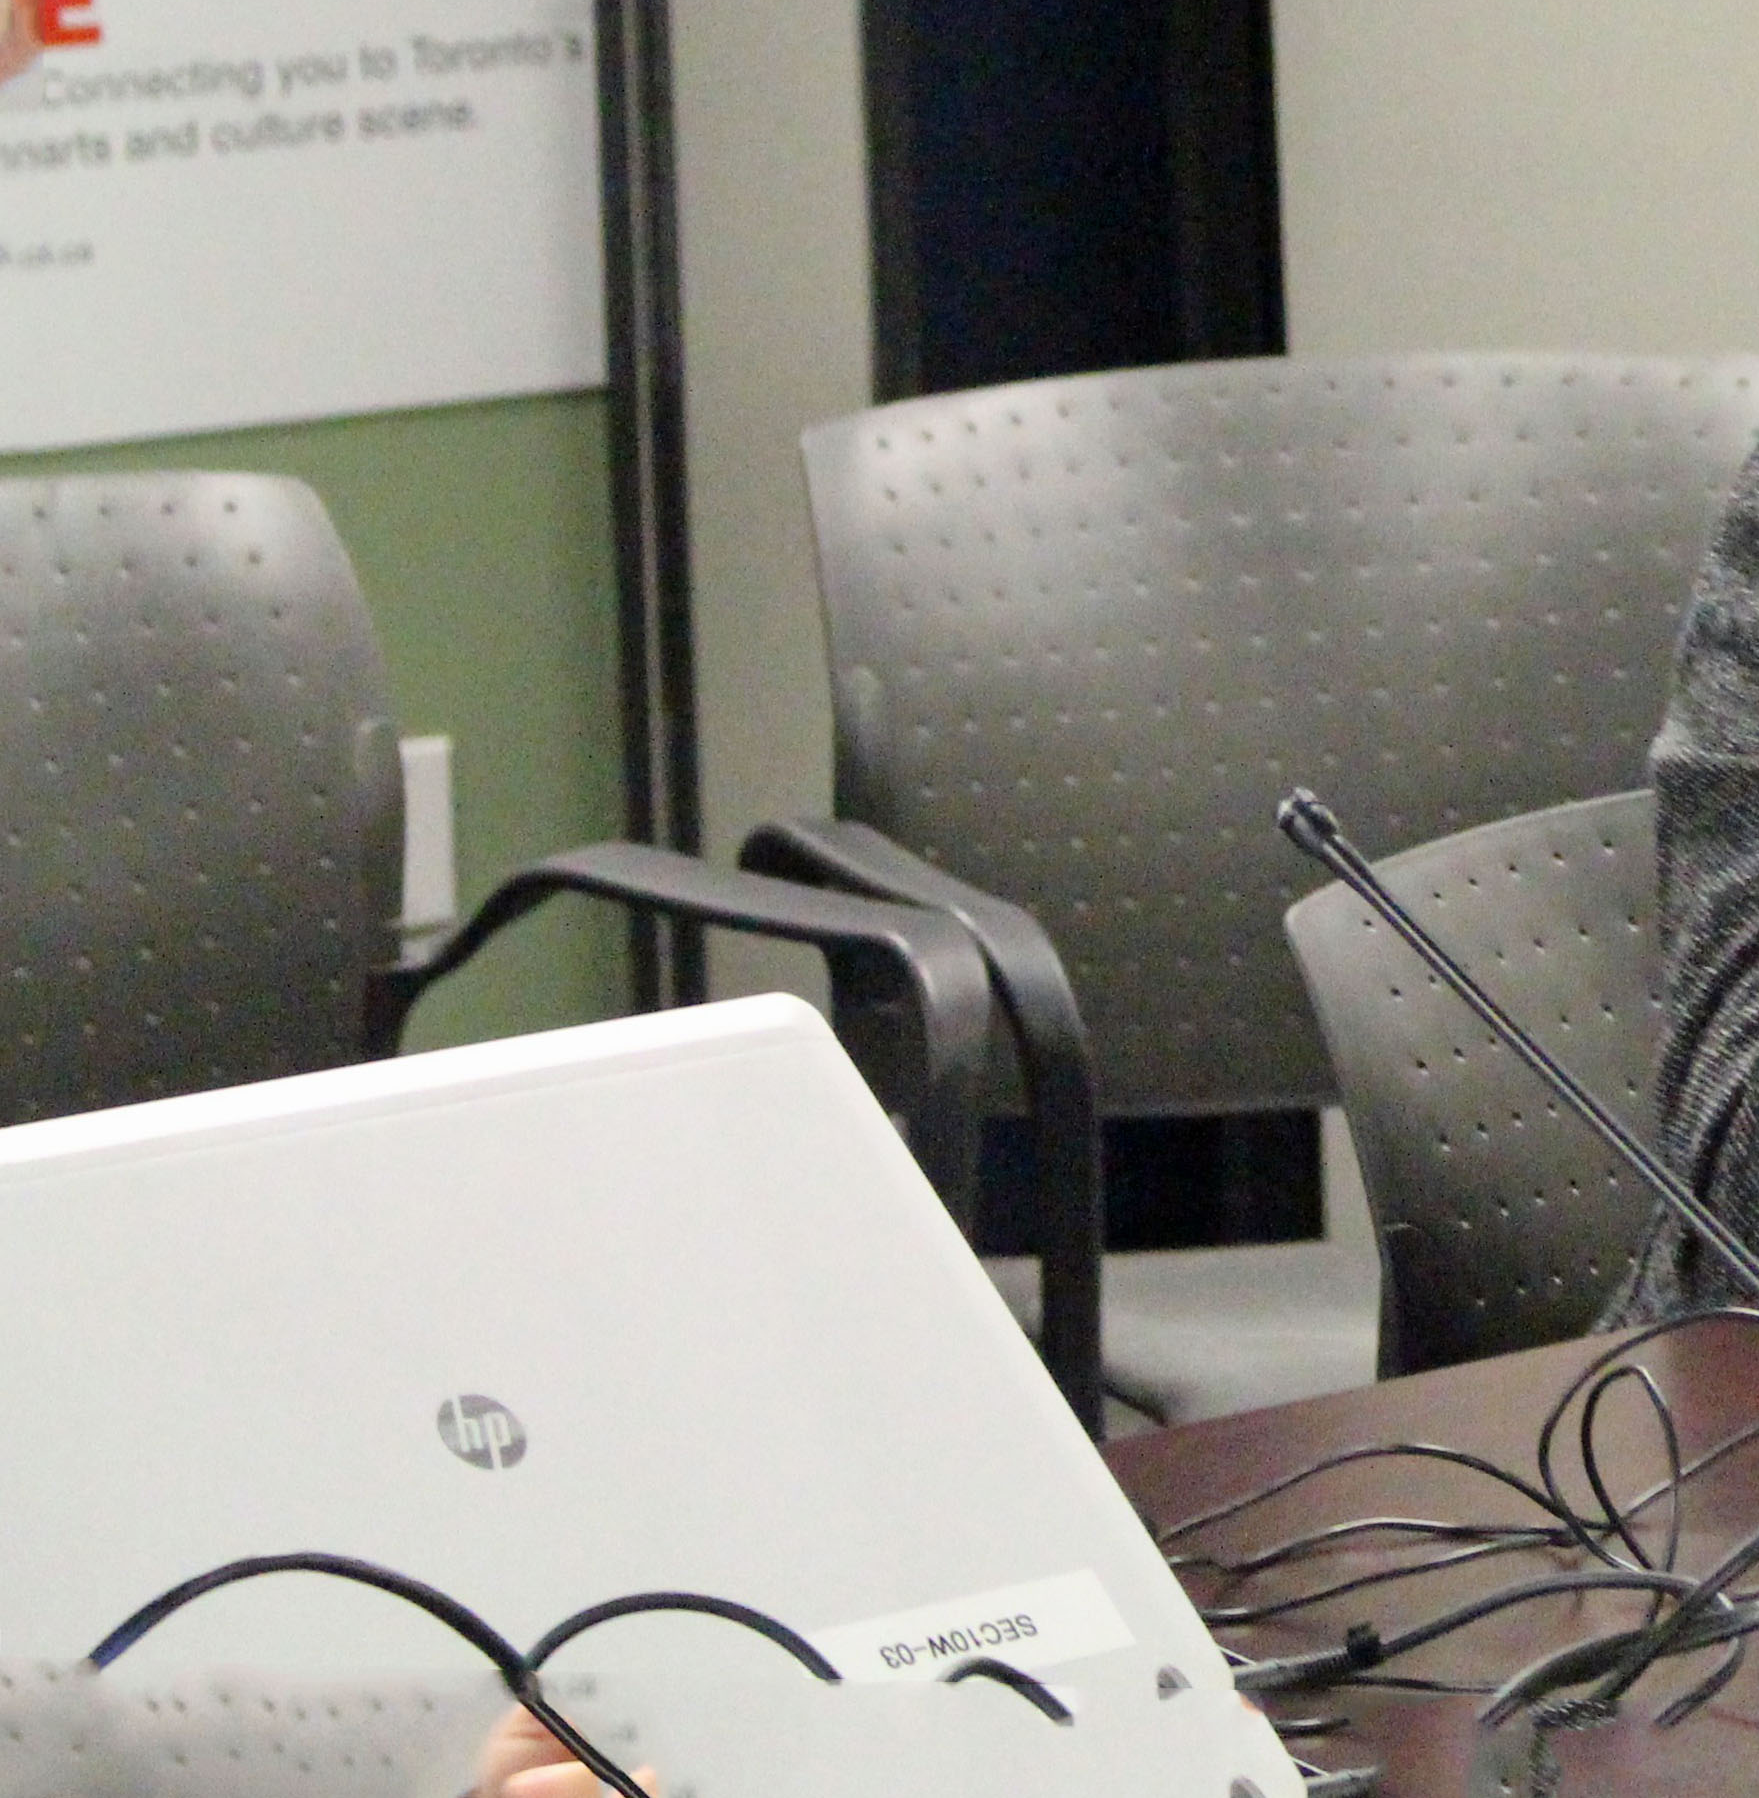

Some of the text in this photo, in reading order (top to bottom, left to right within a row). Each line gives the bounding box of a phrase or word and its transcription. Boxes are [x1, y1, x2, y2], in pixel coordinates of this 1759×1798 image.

[44, 60, 265, 109] Connecting
[275, 52, 349, 96] you
[358, 42, 398, 81] to
[125, 119, 200, 164] and
[209, 111, 346, 154] culture
[450, 1394, 514, 1470] hp
[879, 1614, 1039, 1670] SEC10W-03
